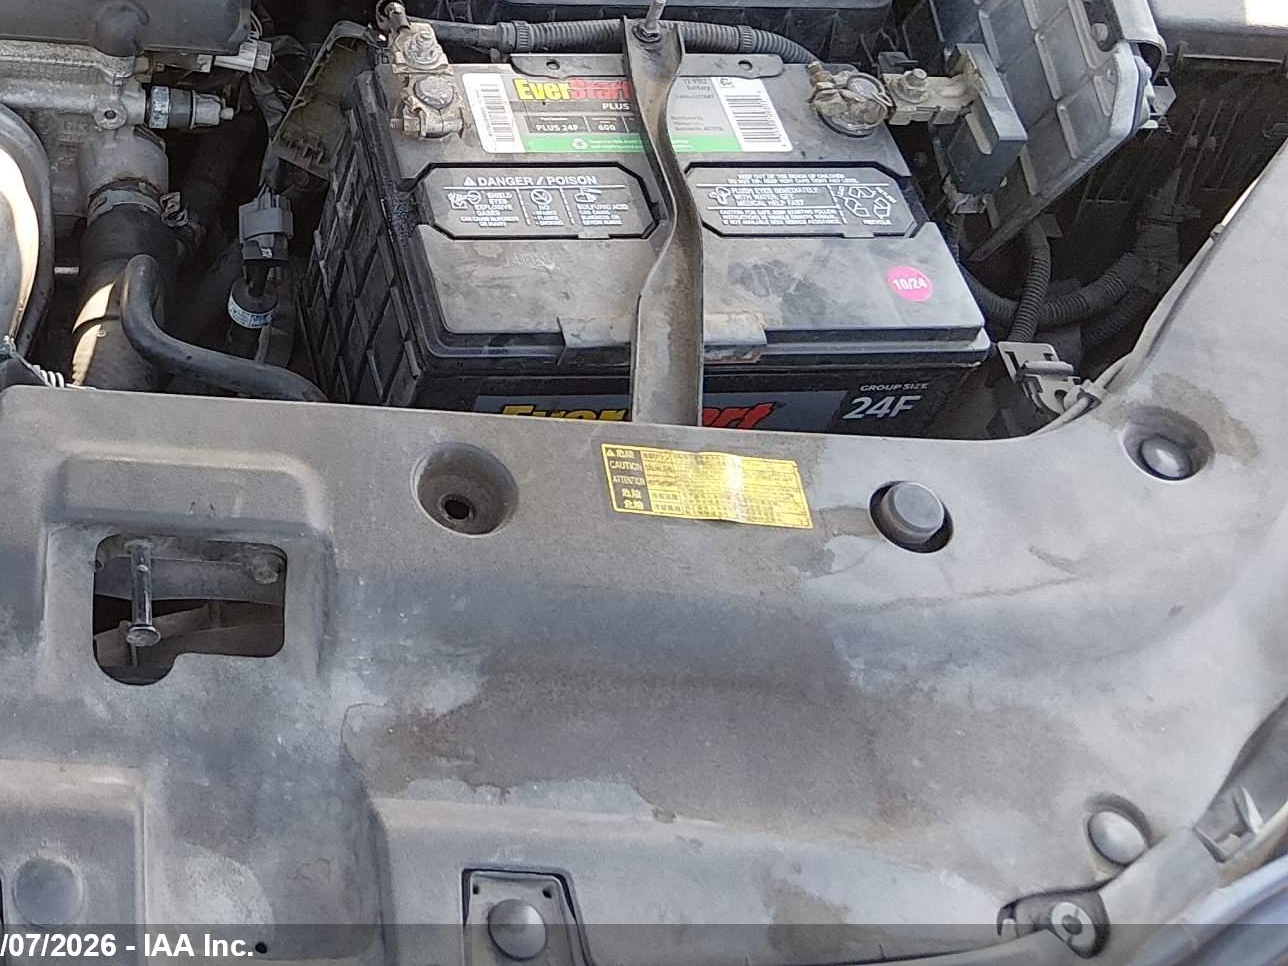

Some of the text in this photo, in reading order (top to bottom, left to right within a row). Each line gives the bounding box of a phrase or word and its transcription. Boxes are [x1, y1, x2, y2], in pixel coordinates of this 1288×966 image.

[512, 78, 632, 101] EverStart
[535, 124, 560, 132] PLUS
[477, 176, 532, 186] DANGER
[547, 175, 597, 185] POISON
[893, 277, 928, 291] 10/24
[842, 395, 921, 419] 24F
[609, 460, 643, 472] CAUTION
[612, 475, 646, 486] ATTENTION
